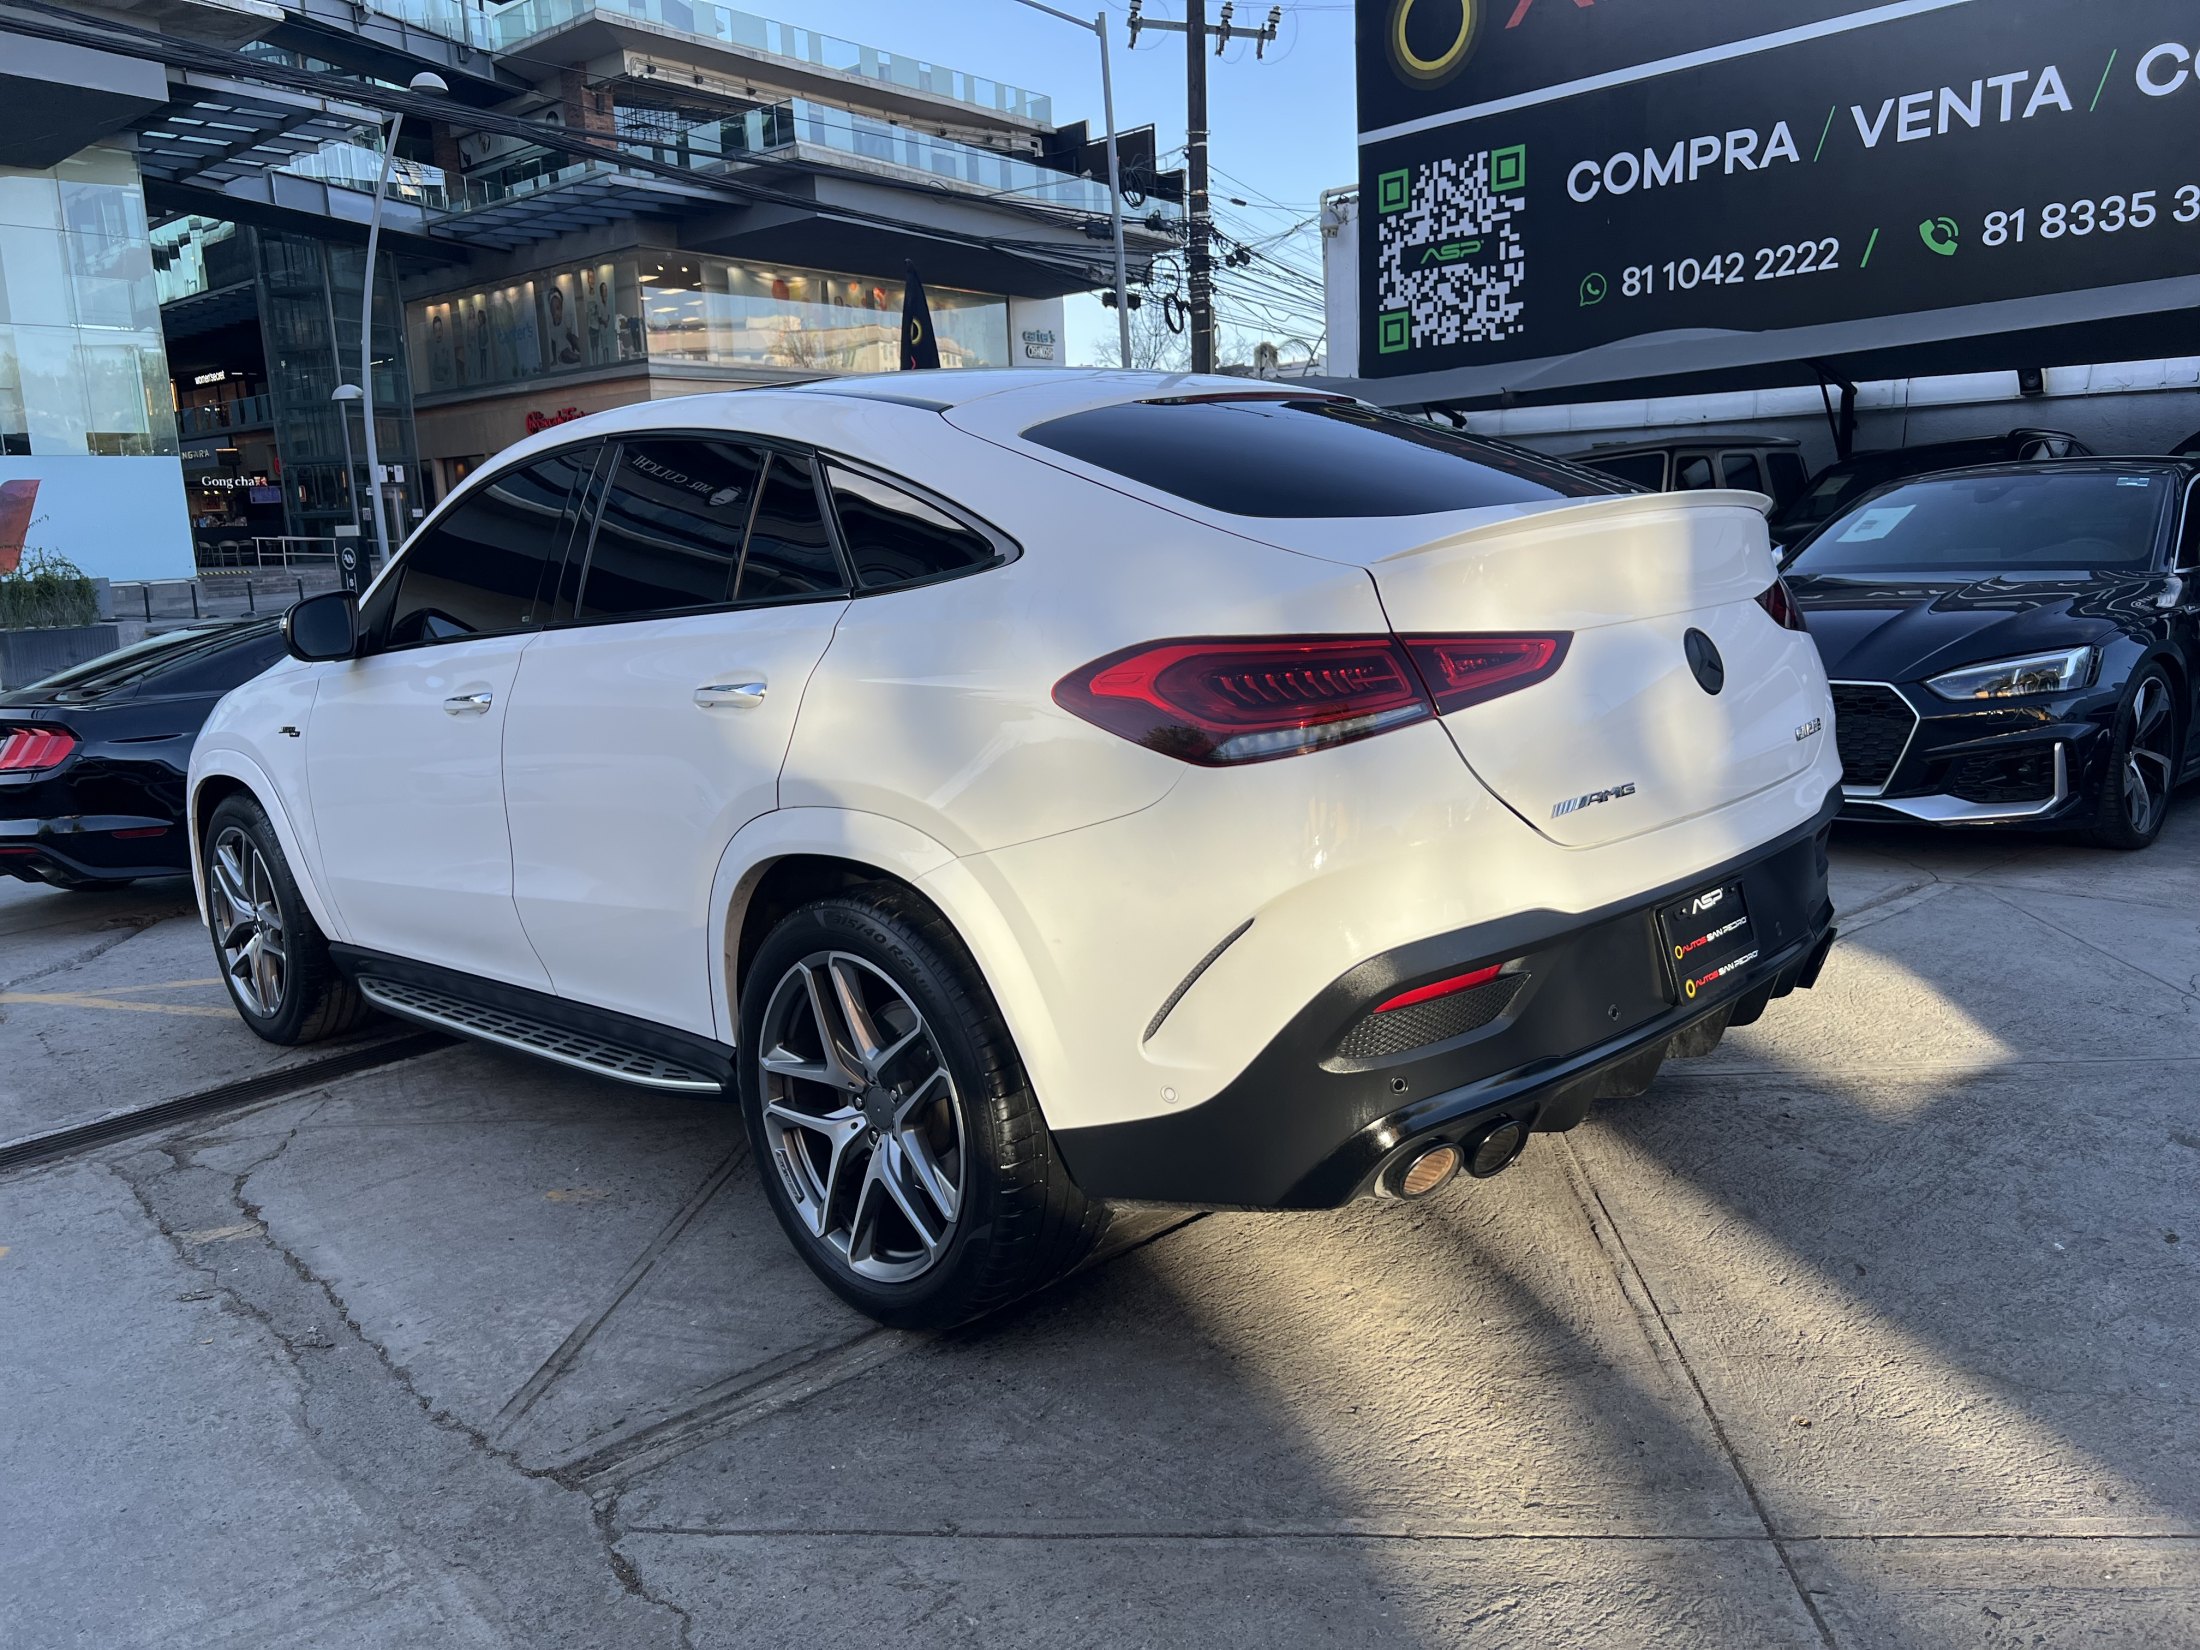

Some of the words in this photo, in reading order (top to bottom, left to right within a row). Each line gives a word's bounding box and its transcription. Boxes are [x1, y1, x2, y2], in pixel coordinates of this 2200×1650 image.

[1566, 120, 1800, 203] COMPRA
[1851, 65, 2073, 149] VENTA
[2135, 42, 2200, 97] C
[1621, 265, 1653, 297] 81
[1662, 252, 1745, 291] 1042
[1755, 237, 1839, 281] 2222
[1982, 207, 2025, 246] 81
[2039, 190, 2157, 239] 8335
[201, 476, 233, 489] Gong
[235, 475, 255, 487] cha
[1692, 888, 1723, 915] ASP
[1682, 935, 1708, 954] AUTOS
[1706, 927, 1724, 942] SAN
[1695, 969, 1720, 988] AUTOS
[1718, 962, 1735, 976] SAN
